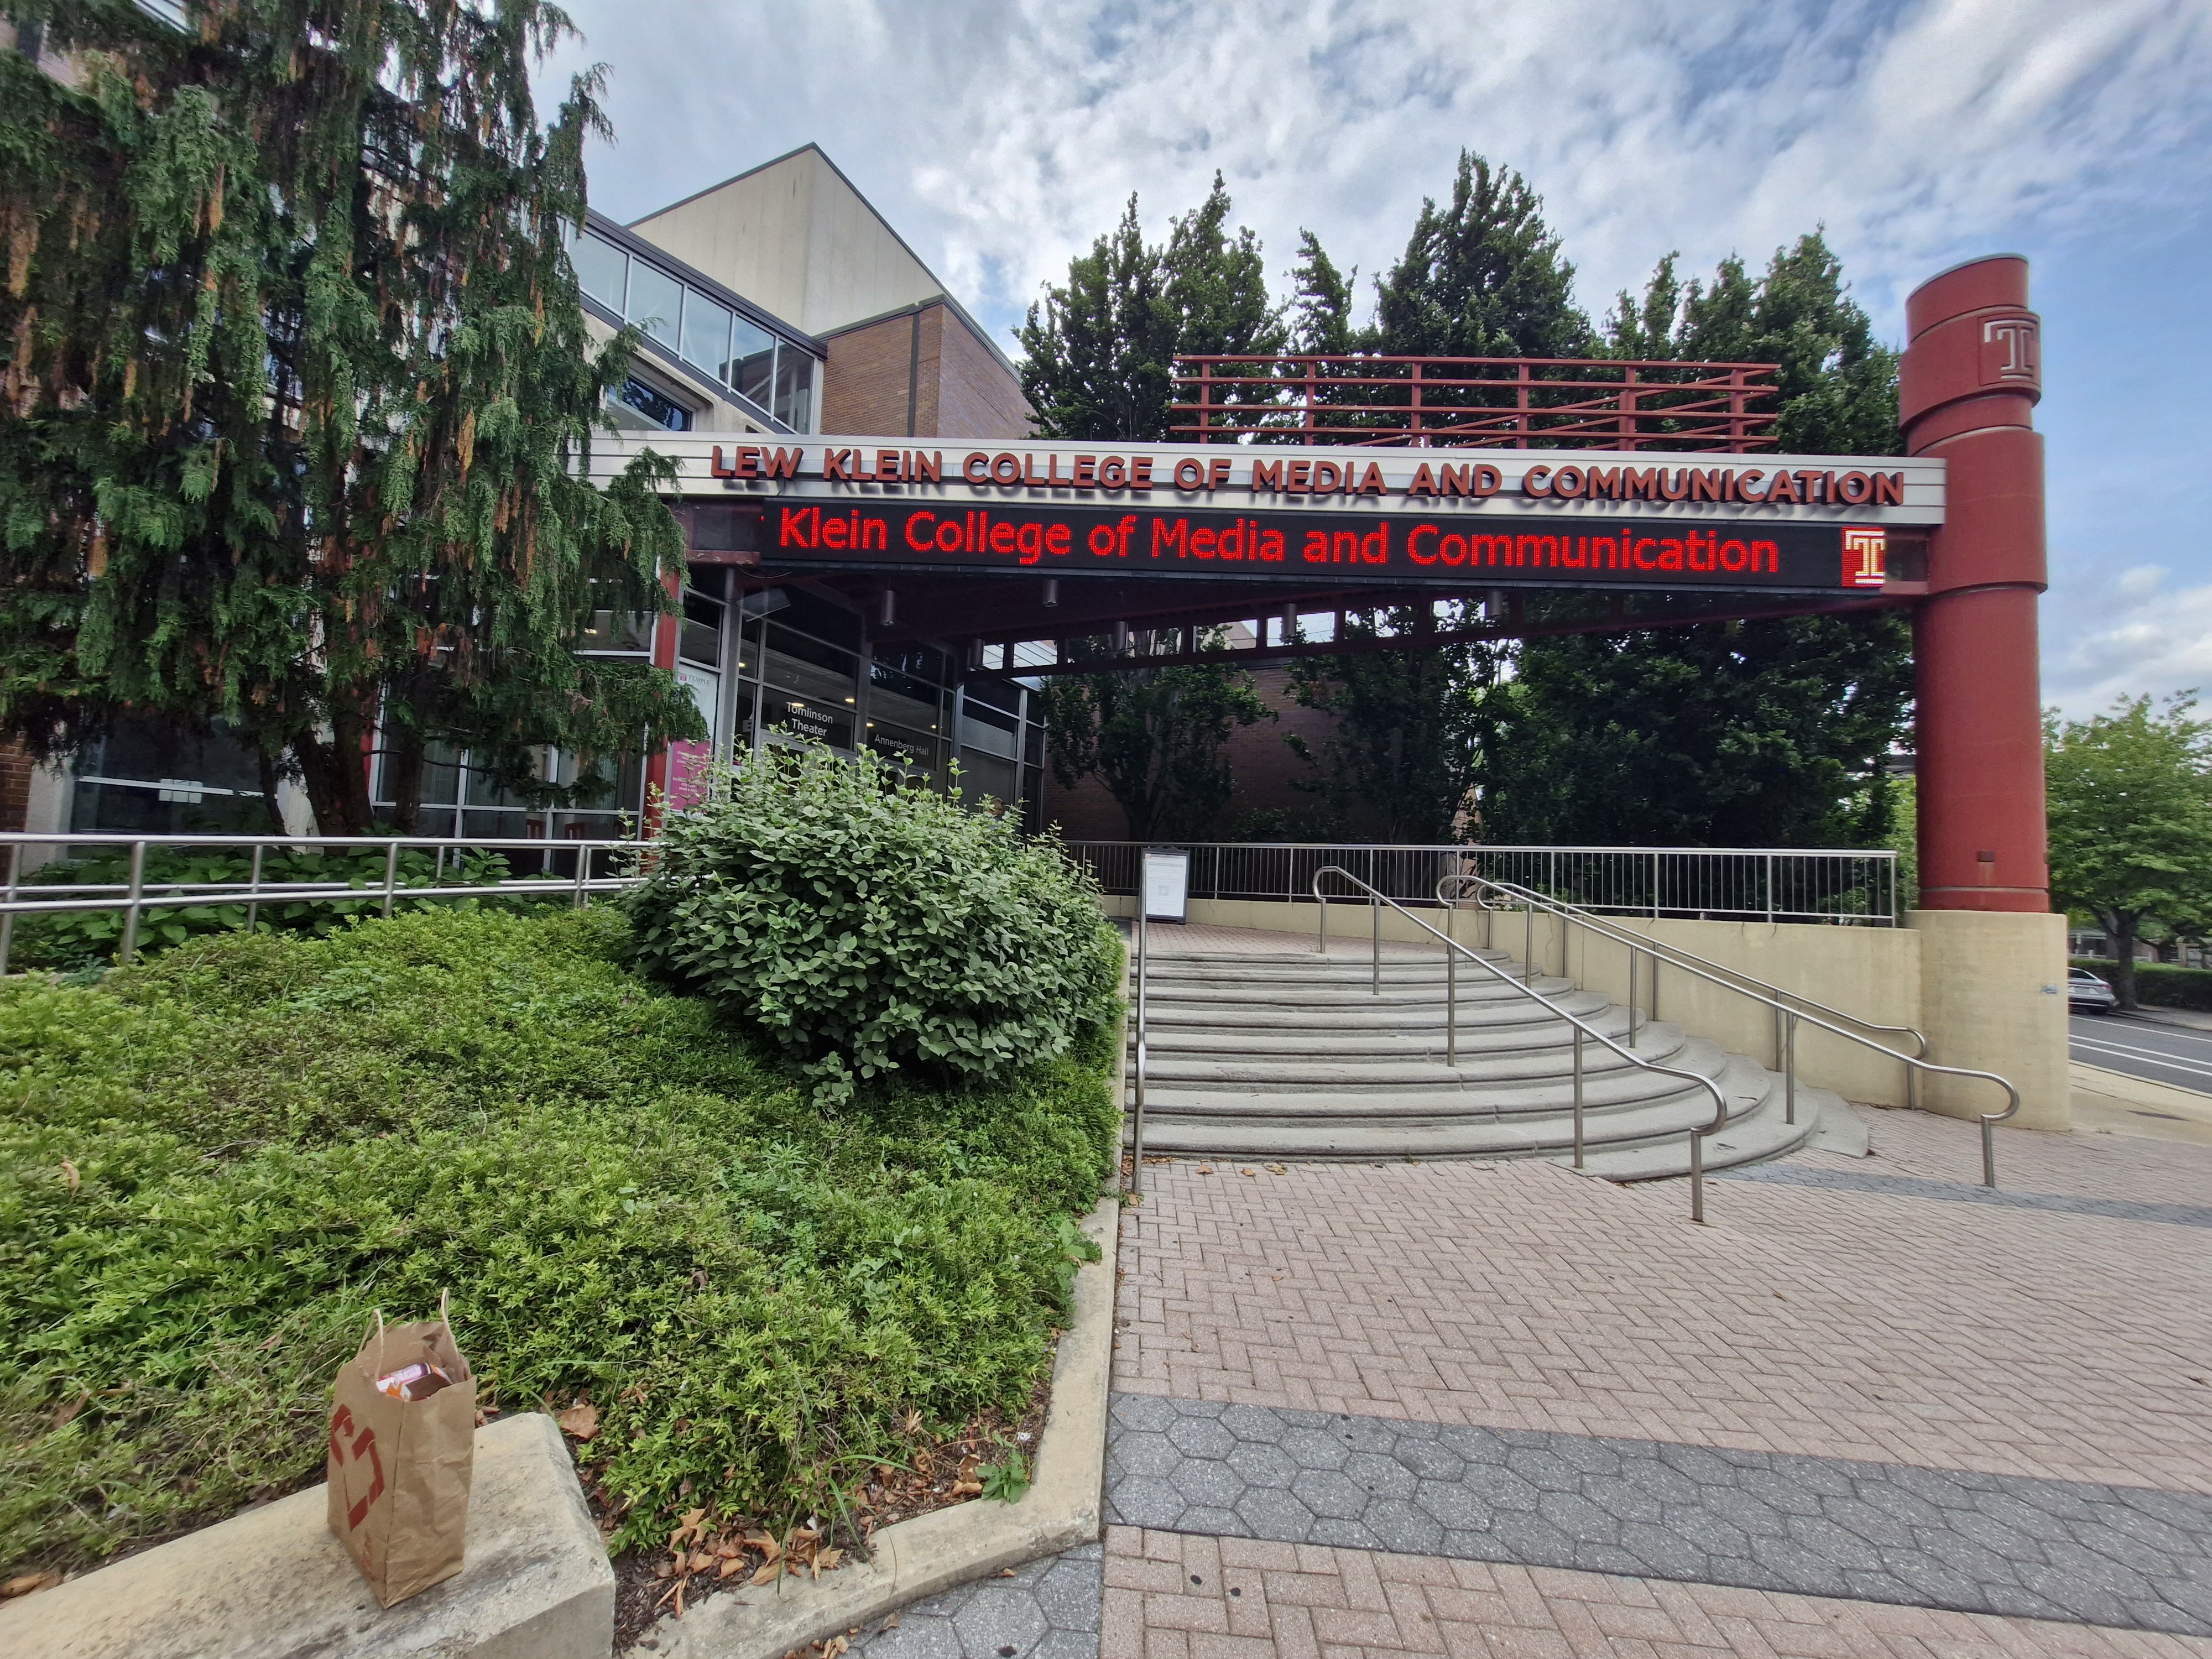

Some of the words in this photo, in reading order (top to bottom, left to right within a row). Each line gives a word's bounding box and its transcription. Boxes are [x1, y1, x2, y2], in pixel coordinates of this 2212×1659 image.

[711, 445, 804, 478] LEW
[822, 448, 942, 484] KLEIN
[962, 451, 1154, 490] COLLEGE
[1173, 457, 1232, 492] OF
[1252, 459, 1388, 495] MEDIA
[1407, 462, 1503, 497] AND
[1521, 465, 1904, 507] COMMUNICATION
[779, 506, 888, 549] Klein
[905, 510, 1071, 565] College
[1088, 514, 1136, 557] of
[1151, 518, 1285, 561] Media
[1303, 521, 1388, 564] and
[1407, 524, 1778, 573] Communication
[688, 674, 710, 685] TEMPLE
[786, 701, 833, 724] Tomlinson
[791, 718, 827, 737] Theater
[874, 734, 914, 753] Annenberg
[916, 746, 929, 756] Hall
